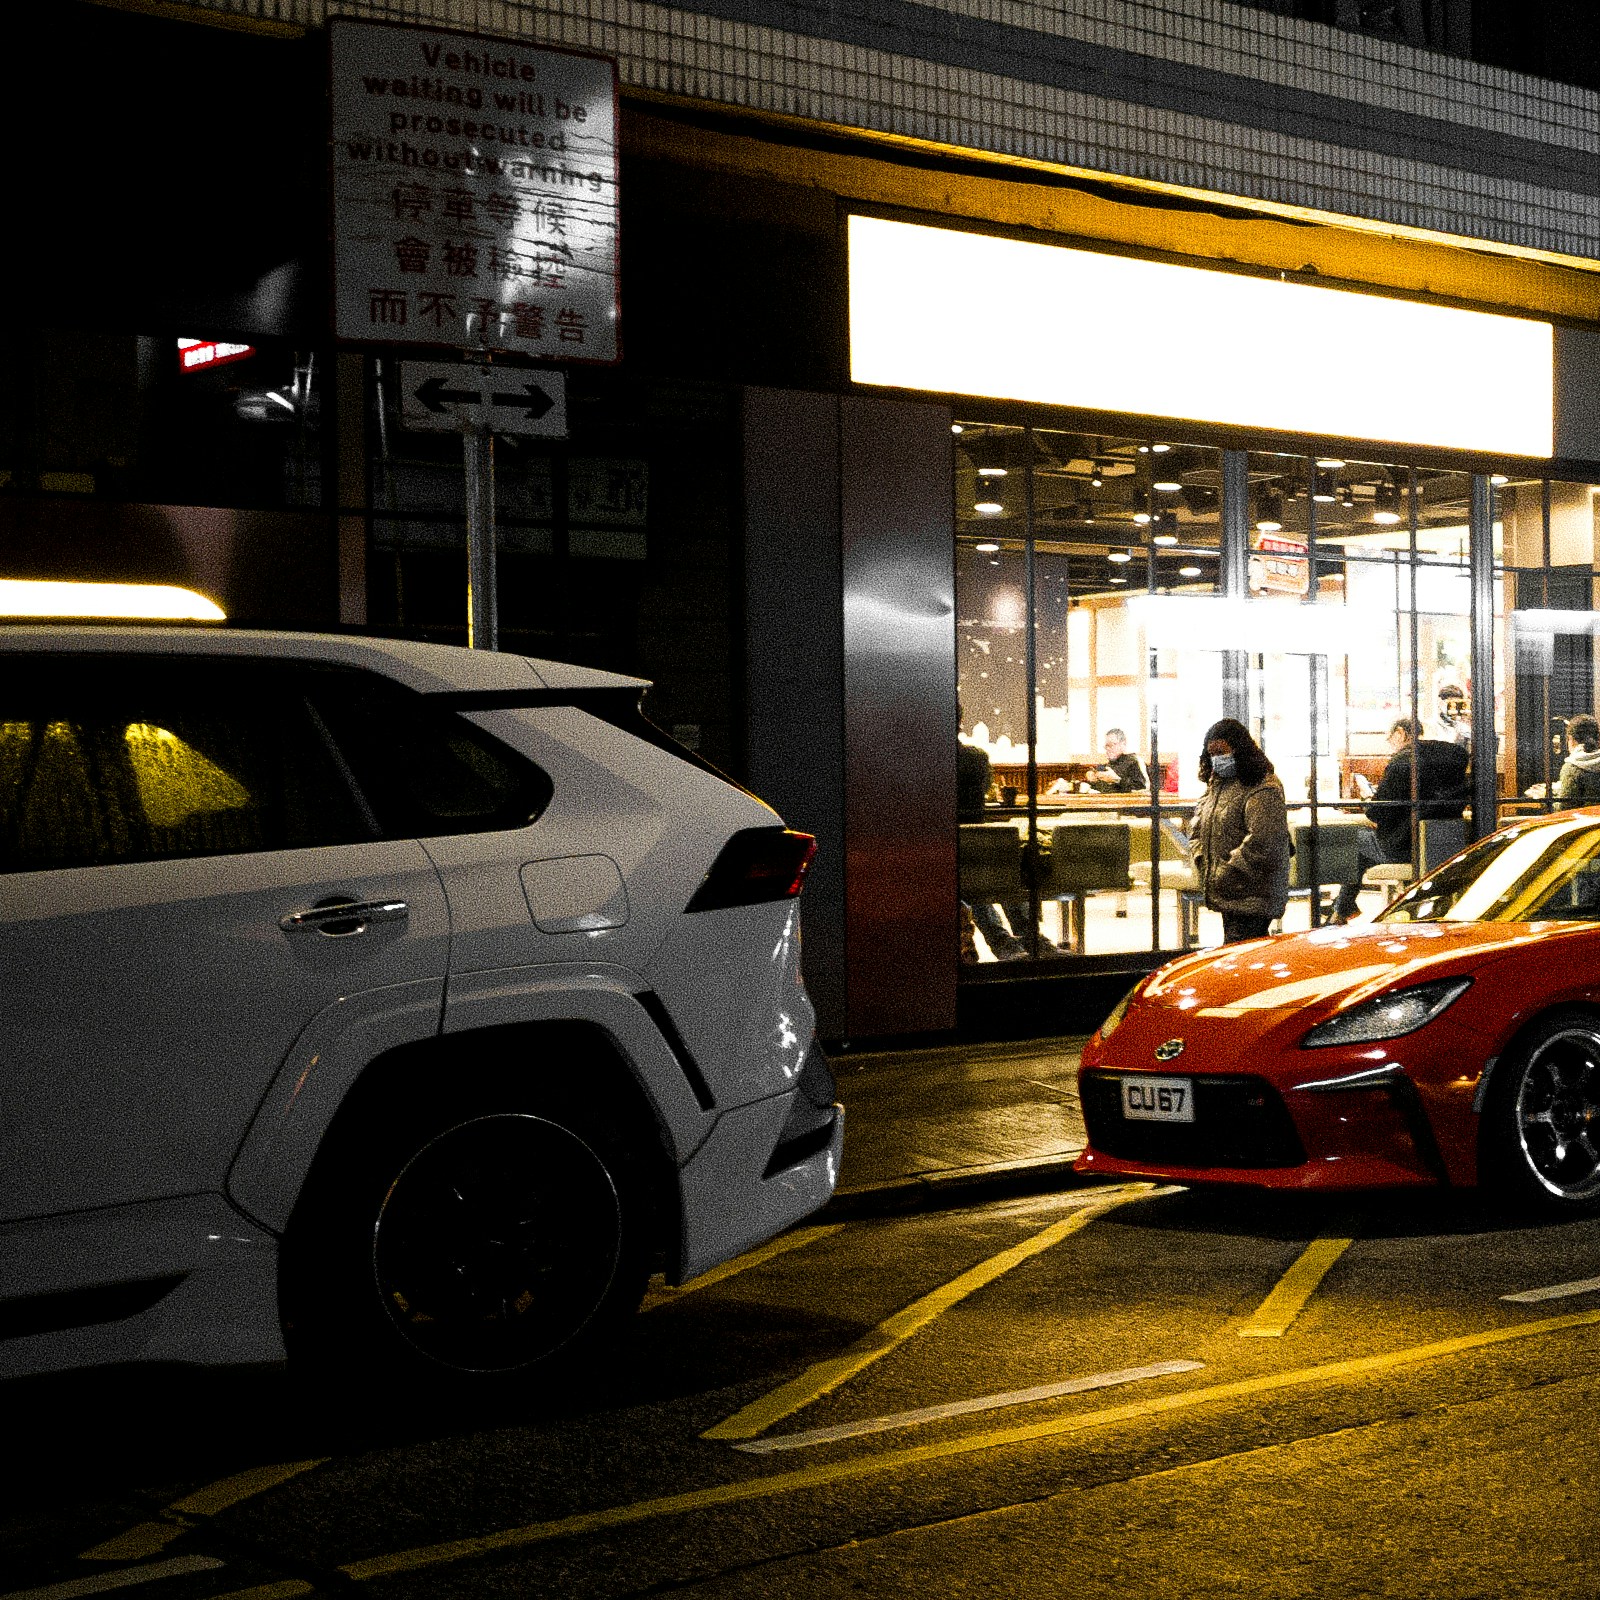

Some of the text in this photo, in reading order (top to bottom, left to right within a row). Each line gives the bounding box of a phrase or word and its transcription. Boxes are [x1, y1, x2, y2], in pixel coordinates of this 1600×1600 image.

[420, 42, 537, 83] Vehicle
[363, 74, 588, 125] waiting will be
[389, 111, 568, 152] prosecuted
[347, 140, 602, 193] without warning
[392, 182, 567, 237] 停車等候
[393, 235, 567, 291] 會被檢控
[368, 287, 590, 345] 而不予警告
